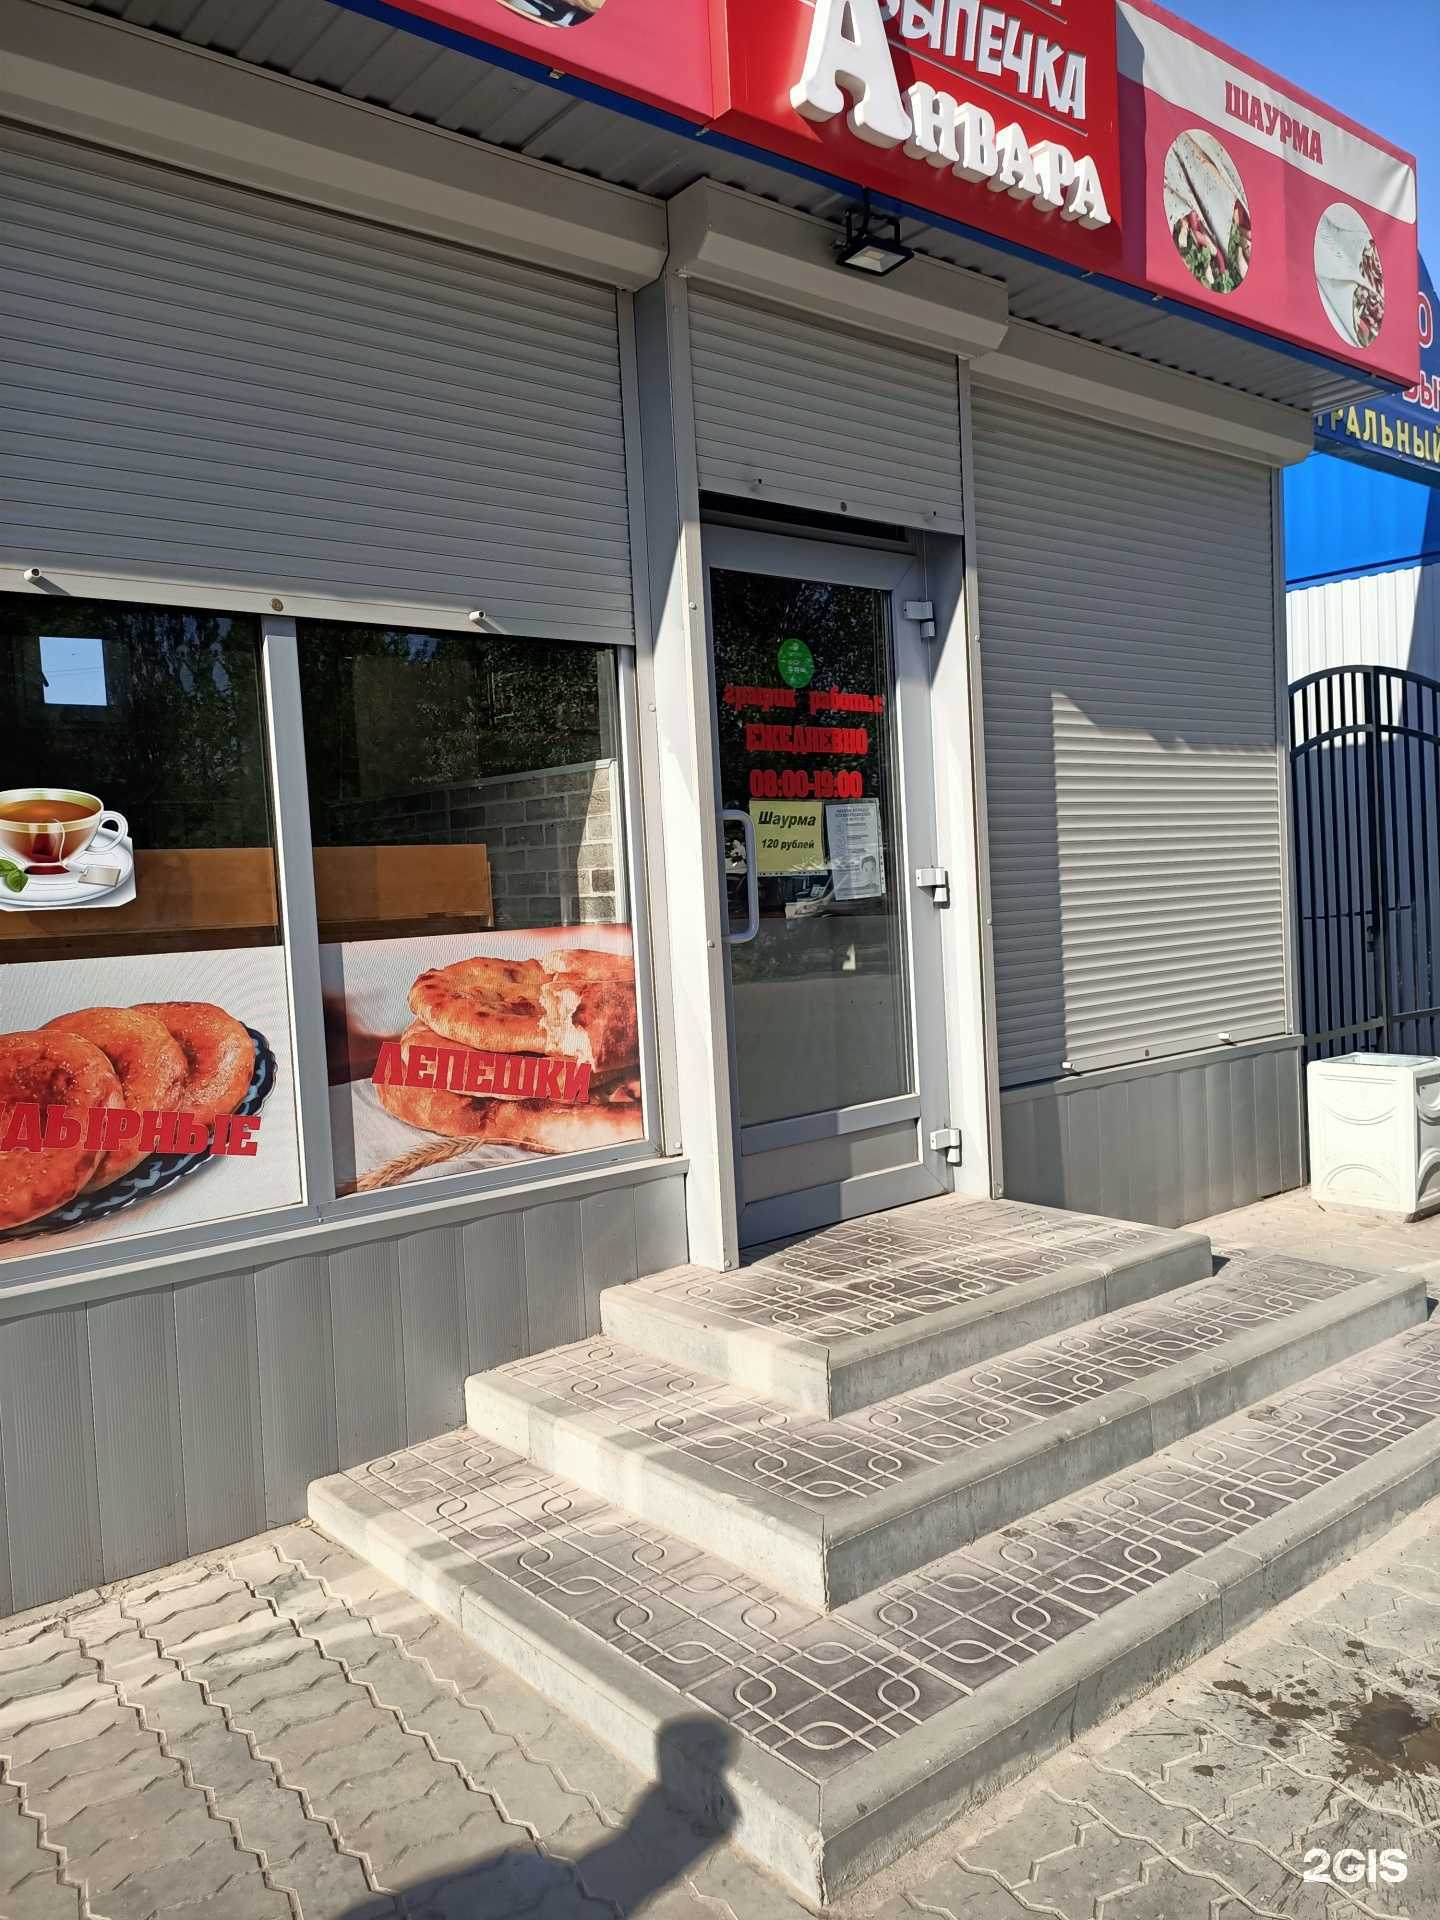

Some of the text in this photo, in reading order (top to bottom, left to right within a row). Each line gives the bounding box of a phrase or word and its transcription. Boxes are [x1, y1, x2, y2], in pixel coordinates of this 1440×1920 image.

[881, 0, 1086, 119] ЫПЕЧКА
[1225, 80, 1323, 165] ШАУРМА
[745, 724, 869, 754] ЕЖЕДНЕВНО
[750, 769, 863, 799] 08:00-19:00
[758, 811, 817, 829] Шаурма
[761, 838, 815, 851] 120 рублей
[371, 1041, 592, 1103] ЛЕПЕШКИ
[0, 1102, 261, 1157] ДЫРНЫЕ
